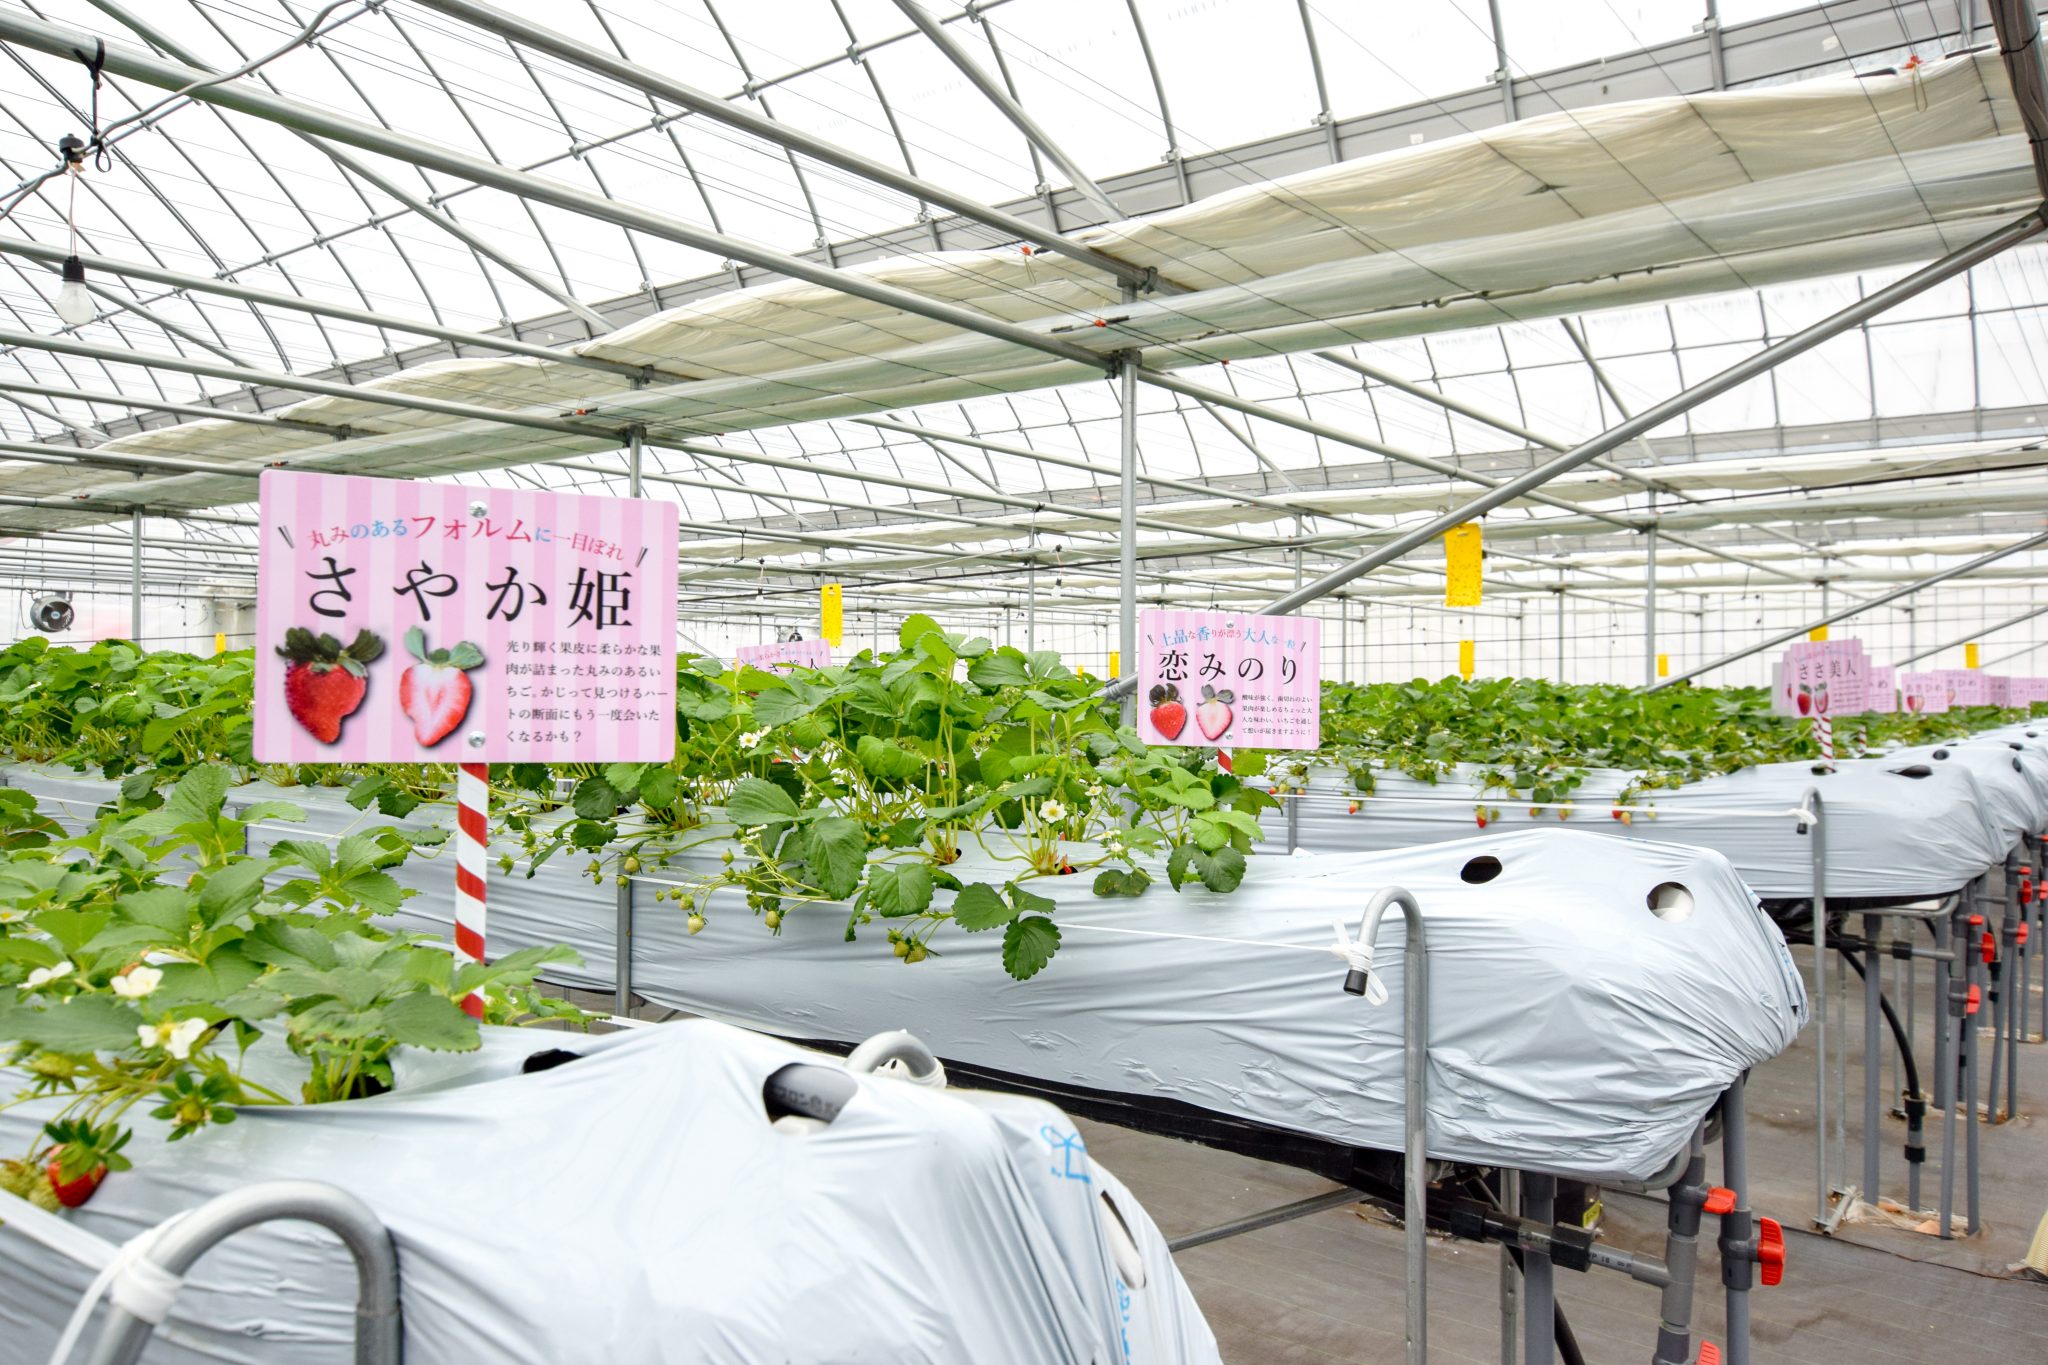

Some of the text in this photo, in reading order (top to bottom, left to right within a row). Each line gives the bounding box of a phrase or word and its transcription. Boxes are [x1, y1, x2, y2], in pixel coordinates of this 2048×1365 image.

[308, 516, 624, 561] 丸みのあるフォルムに一目ぼれ
[305, 557, 633, 630] さやか姫
[506, 640, 662, 656] 光り輝く果皮に柔らかな果
[505, 662, 661, 677] 肉が詰まった丸みのあるい
[1158, 649, 1297, 685] 恋みのり
[506, 686, 668, 699] ちご。かじって見つけるハー
[508, 708, 660, 721] トの断面にもう一度会いた
